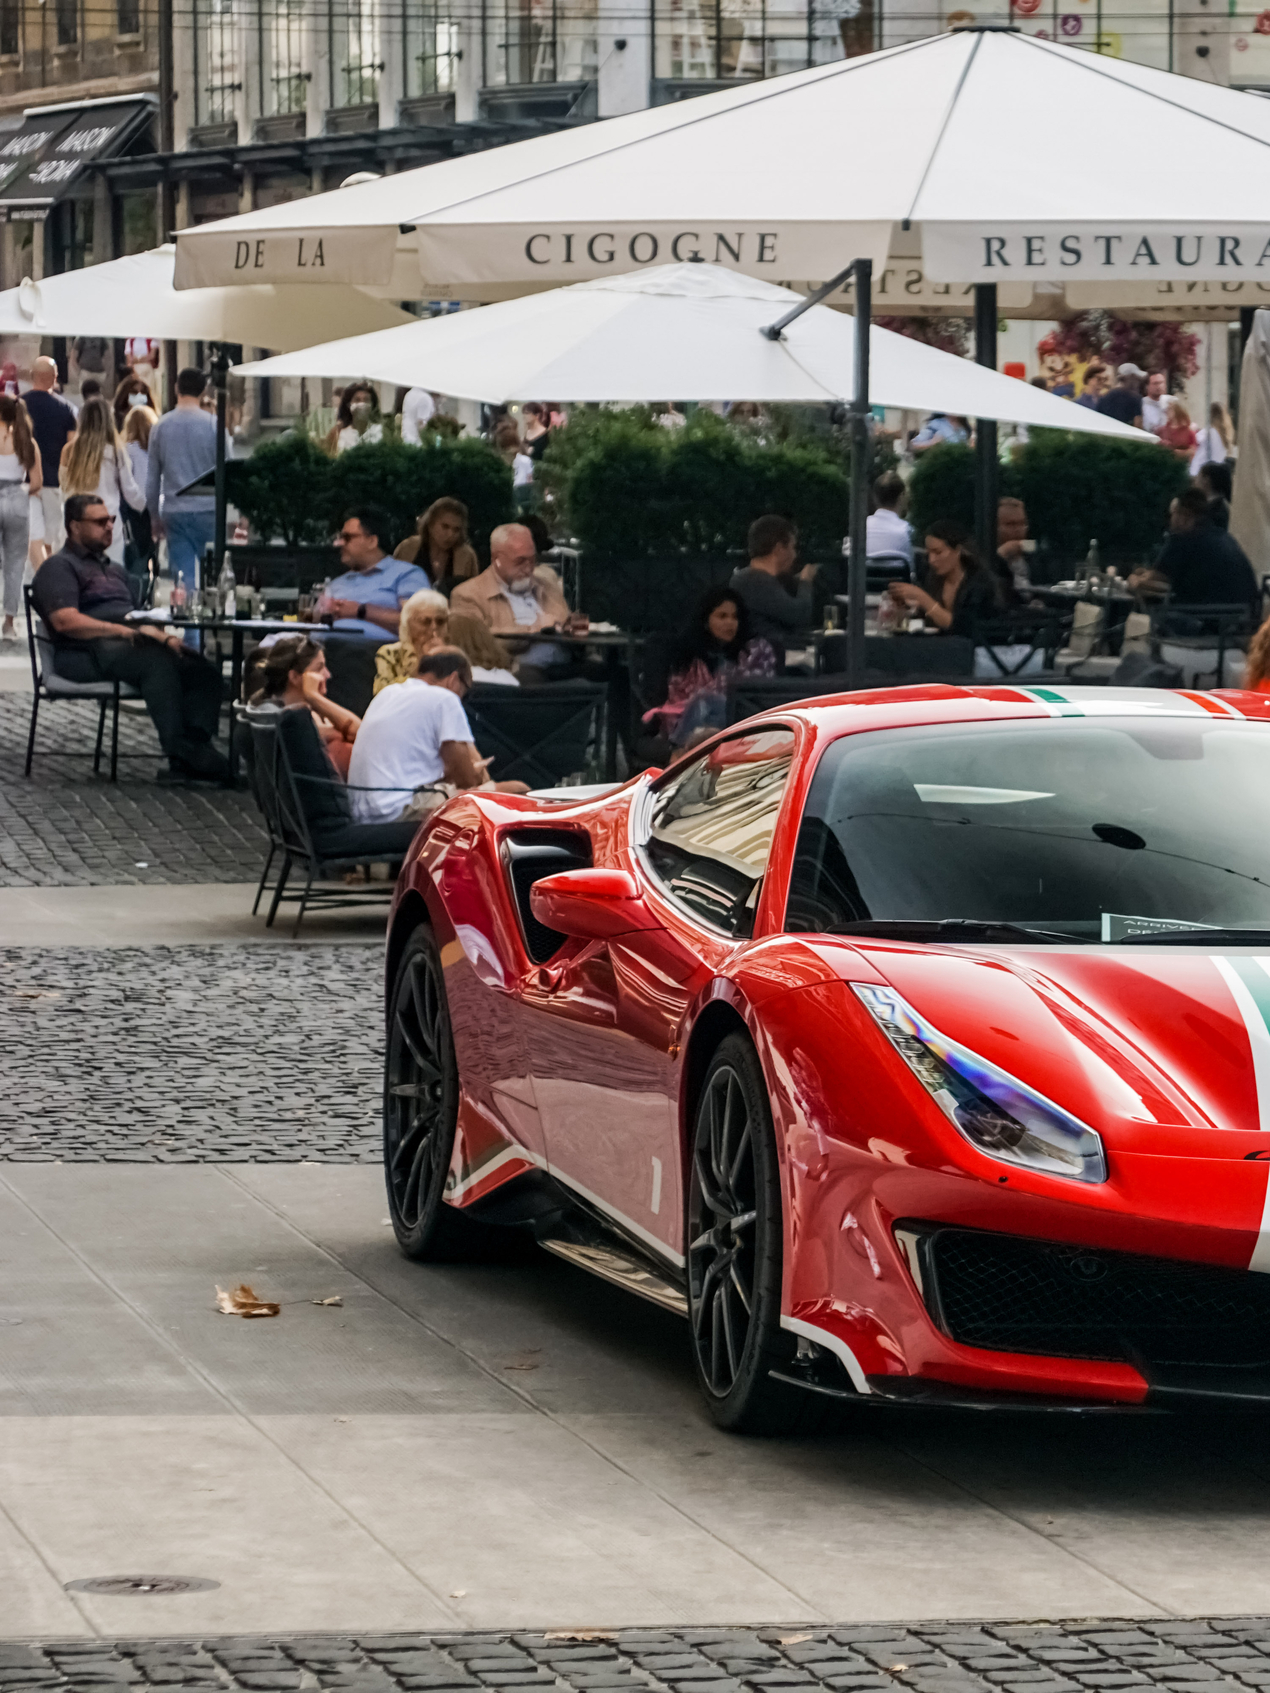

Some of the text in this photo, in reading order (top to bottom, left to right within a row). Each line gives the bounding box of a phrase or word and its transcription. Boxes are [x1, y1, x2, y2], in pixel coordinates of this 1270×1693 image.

[55, 125, 117, 154] MAISON
[234, 238, 326, 269] DE LA
[524, 232, 778, 264] CIGOGNE
